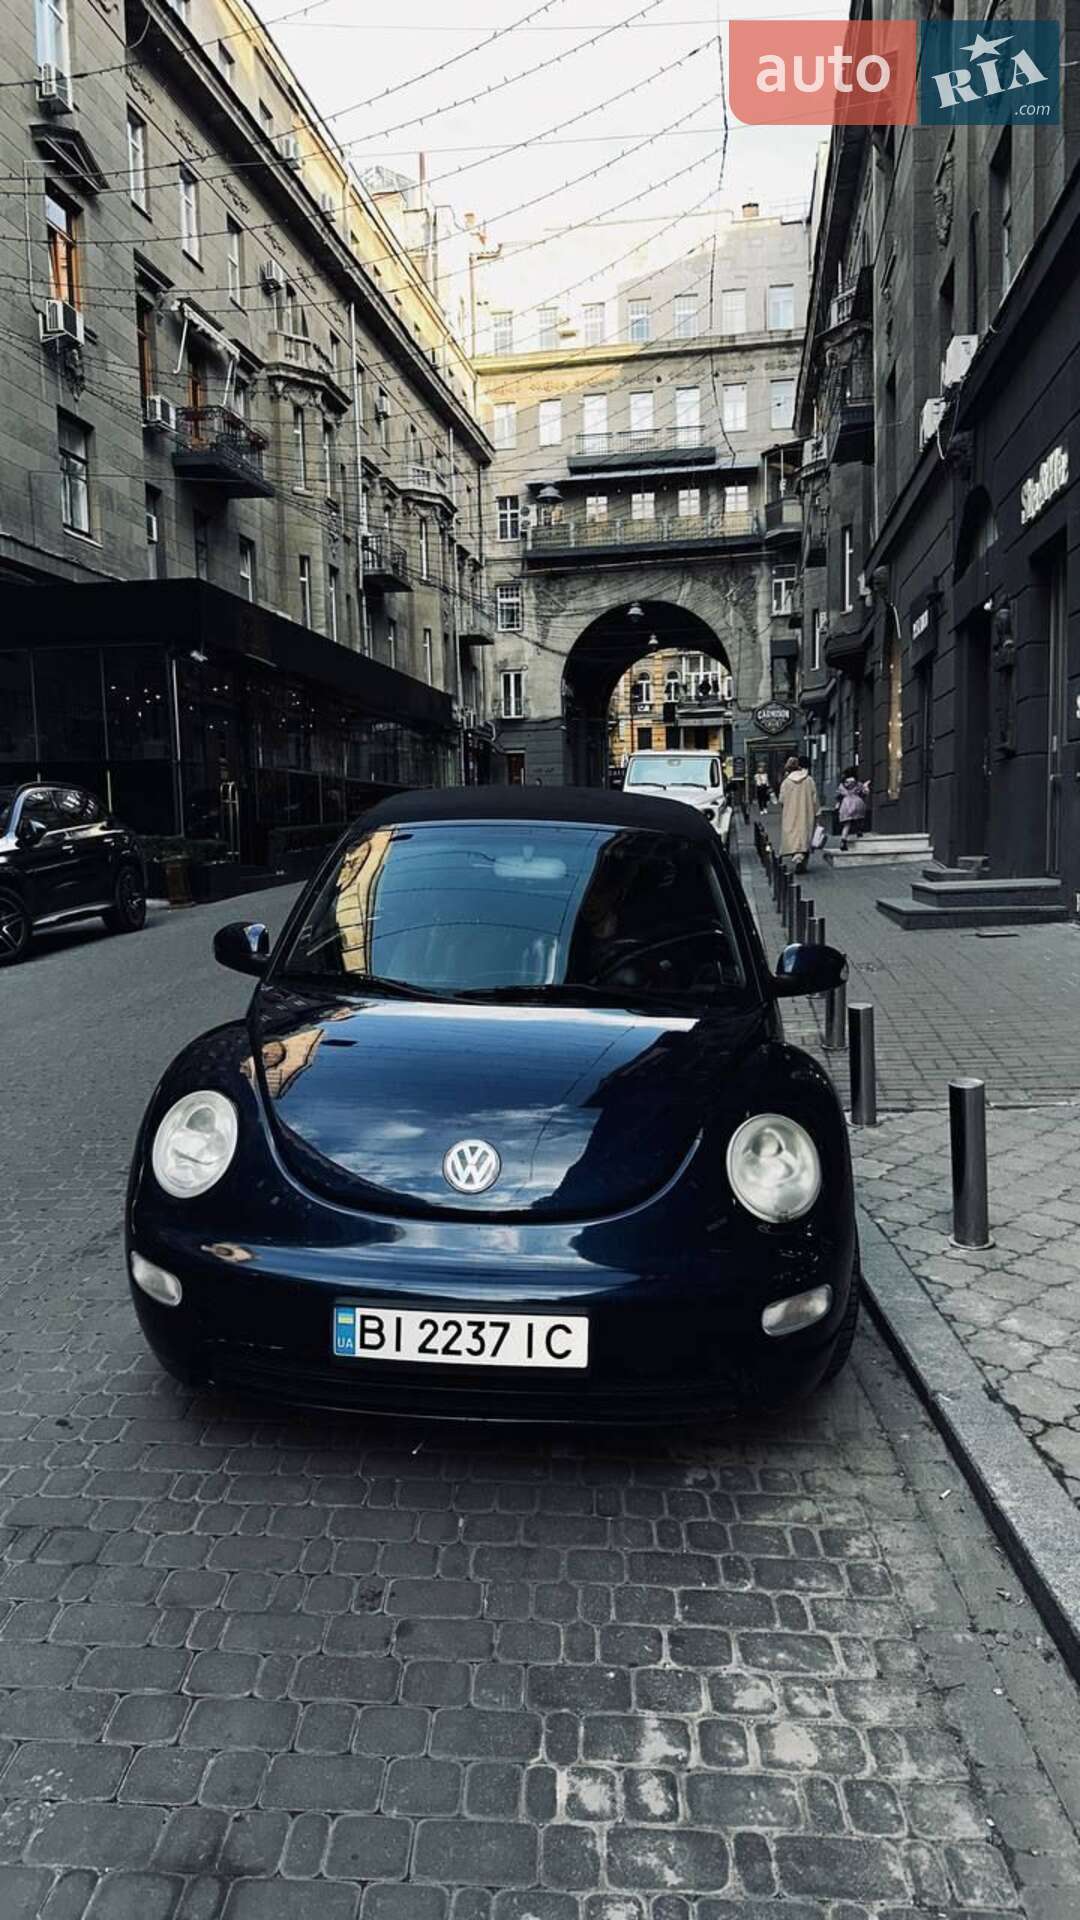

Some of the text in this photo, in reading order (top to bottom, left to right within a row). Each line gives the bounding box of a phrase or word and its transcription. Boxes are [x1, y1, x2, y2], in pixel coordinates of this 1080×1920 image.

[337, 1337, 353, 1348] UA
[359, 1315, 573, 1360] BI 2237 IC
